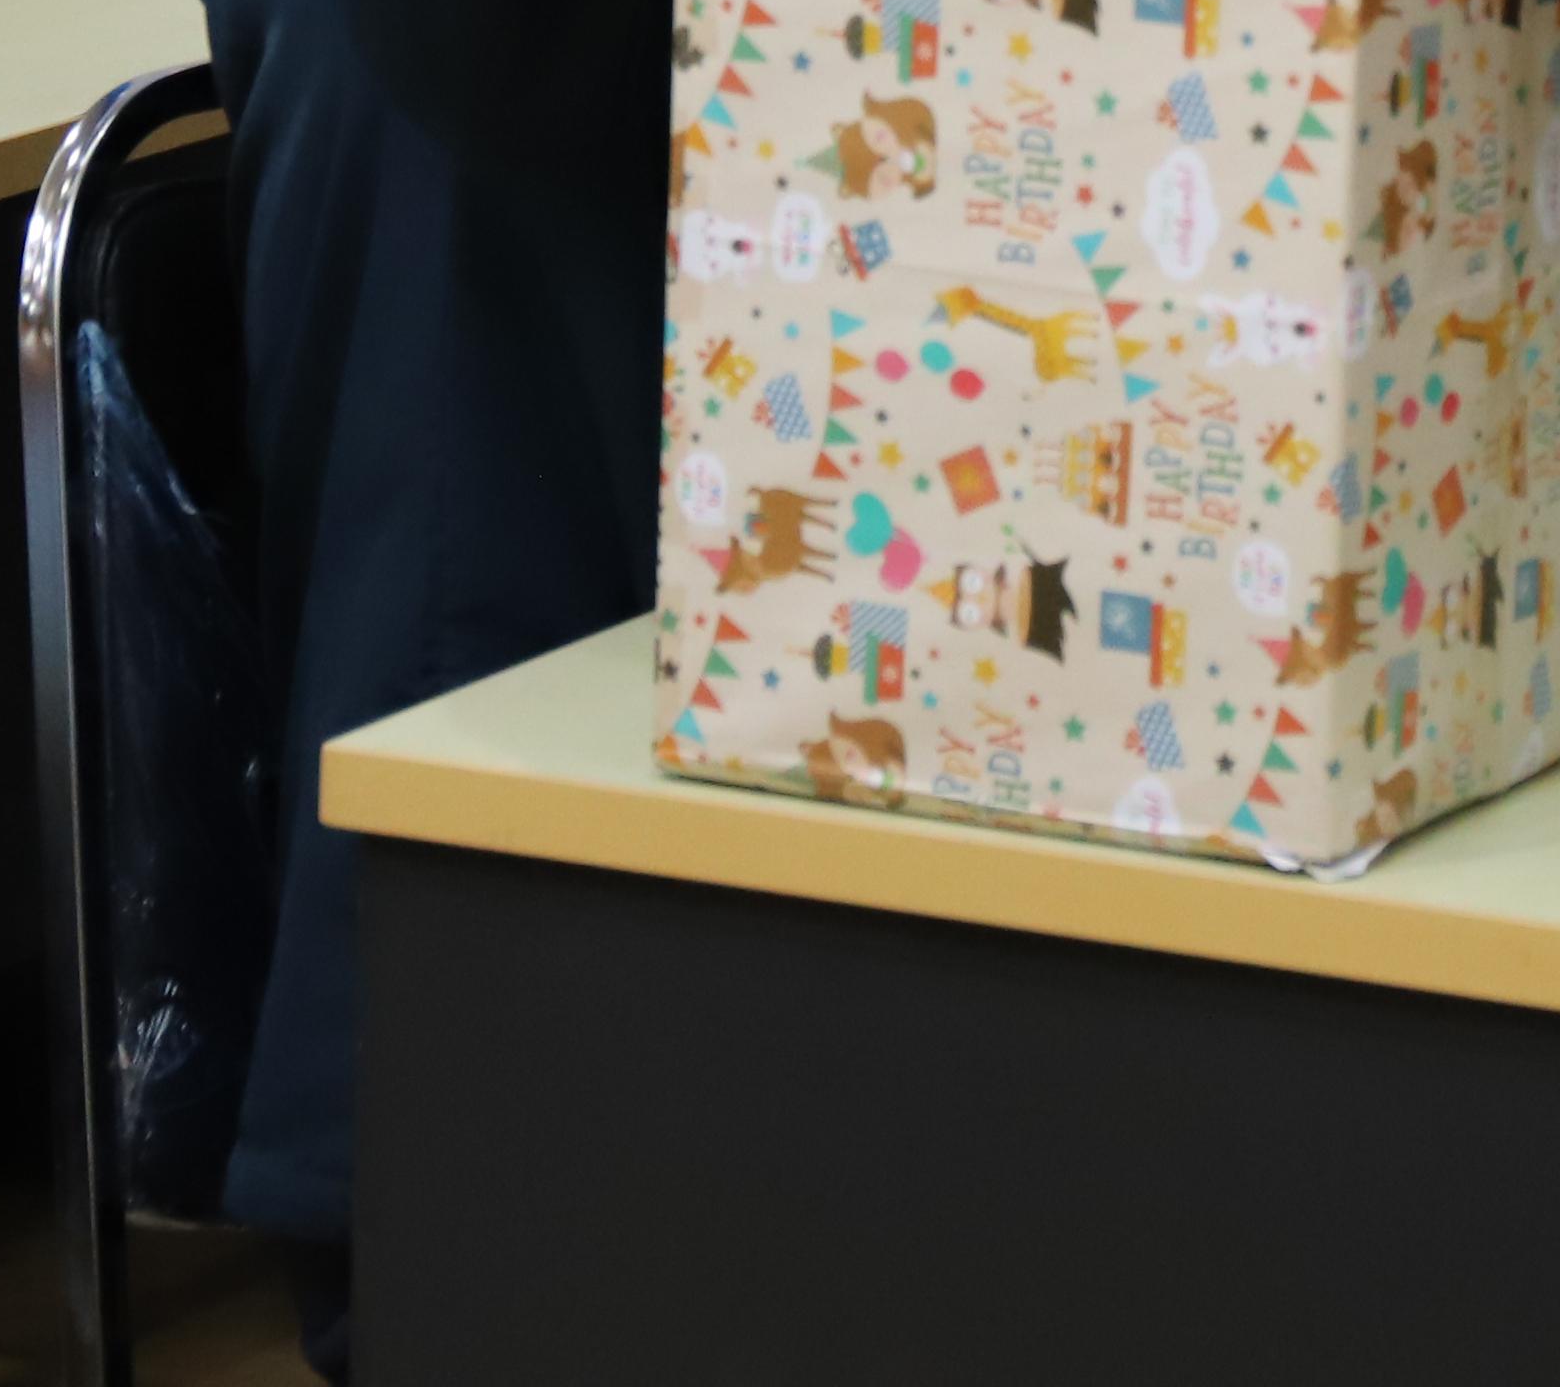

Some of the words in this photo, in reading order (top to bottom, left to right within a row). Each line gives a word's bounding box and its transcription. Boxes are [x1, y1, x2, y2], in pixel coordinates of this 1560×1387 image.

[963, 105, 1012, 228] HAPPY
[996, 77, 1063, 267] BIRTHDAY
[1142, 398, 1192, 523] HAPPY
[1178, 372, 1244, 561] BIRTHDAY
